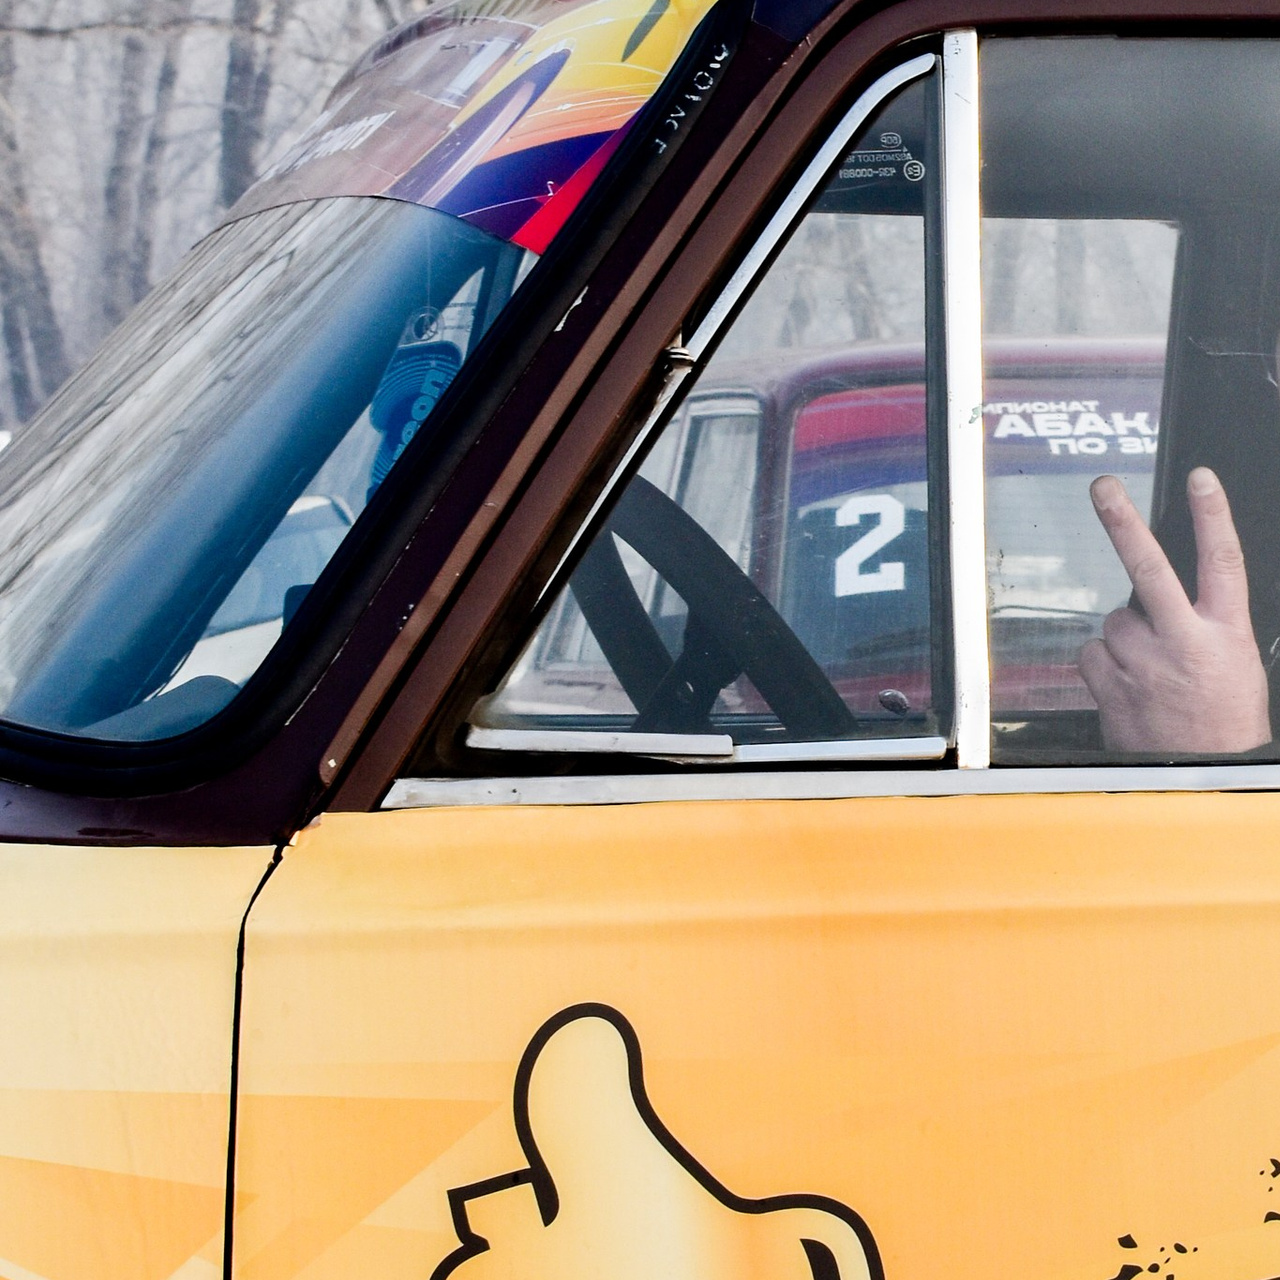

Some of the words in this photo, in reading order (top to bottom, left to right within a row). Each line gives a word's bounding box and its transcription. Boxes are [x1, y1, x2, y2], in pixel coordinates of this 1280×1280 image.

[993, 412, 1160, 438] АБАК
[1048, 437, 1108, 455] ПО
[835, 494, 905, 597] 2
